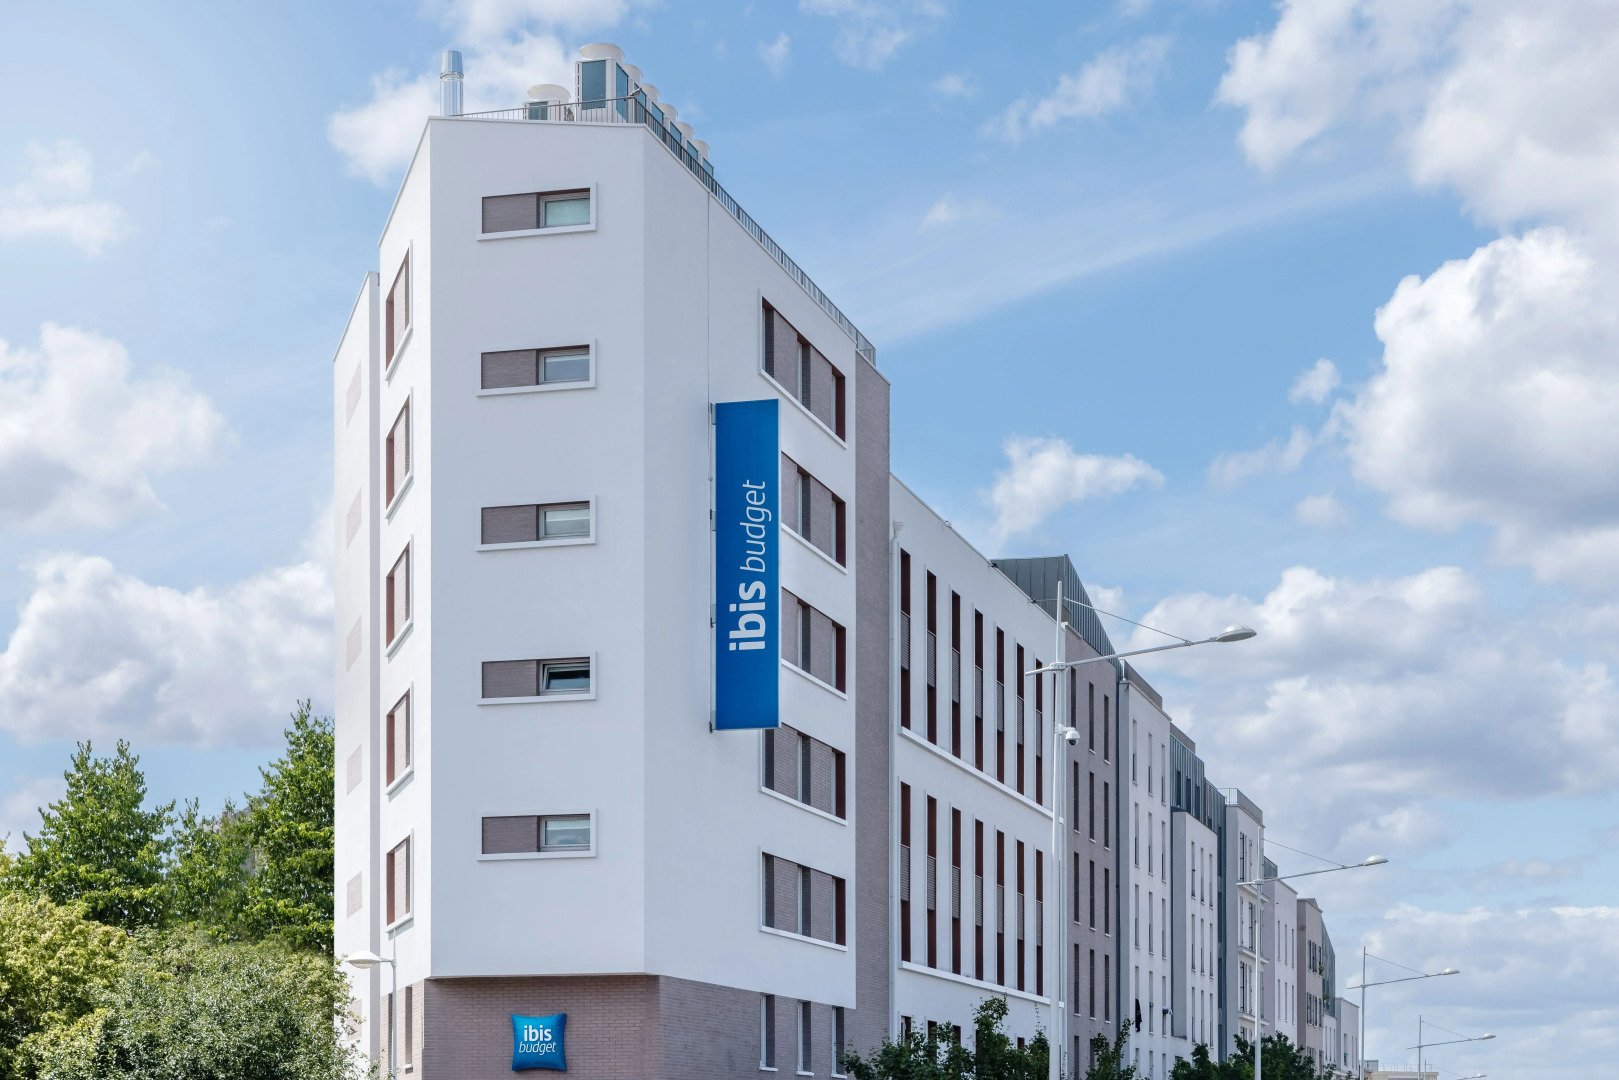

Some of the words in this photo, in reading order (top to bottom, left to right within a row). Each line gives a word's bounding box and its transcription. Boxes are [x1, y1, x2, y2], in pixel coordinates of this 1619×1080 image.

[739, 479, 772, 573] budget
[729, 580, 766, 651] ibis
[518, 1041, 557, 1055] budget
[523, 1024, 552, 1041] ibis
